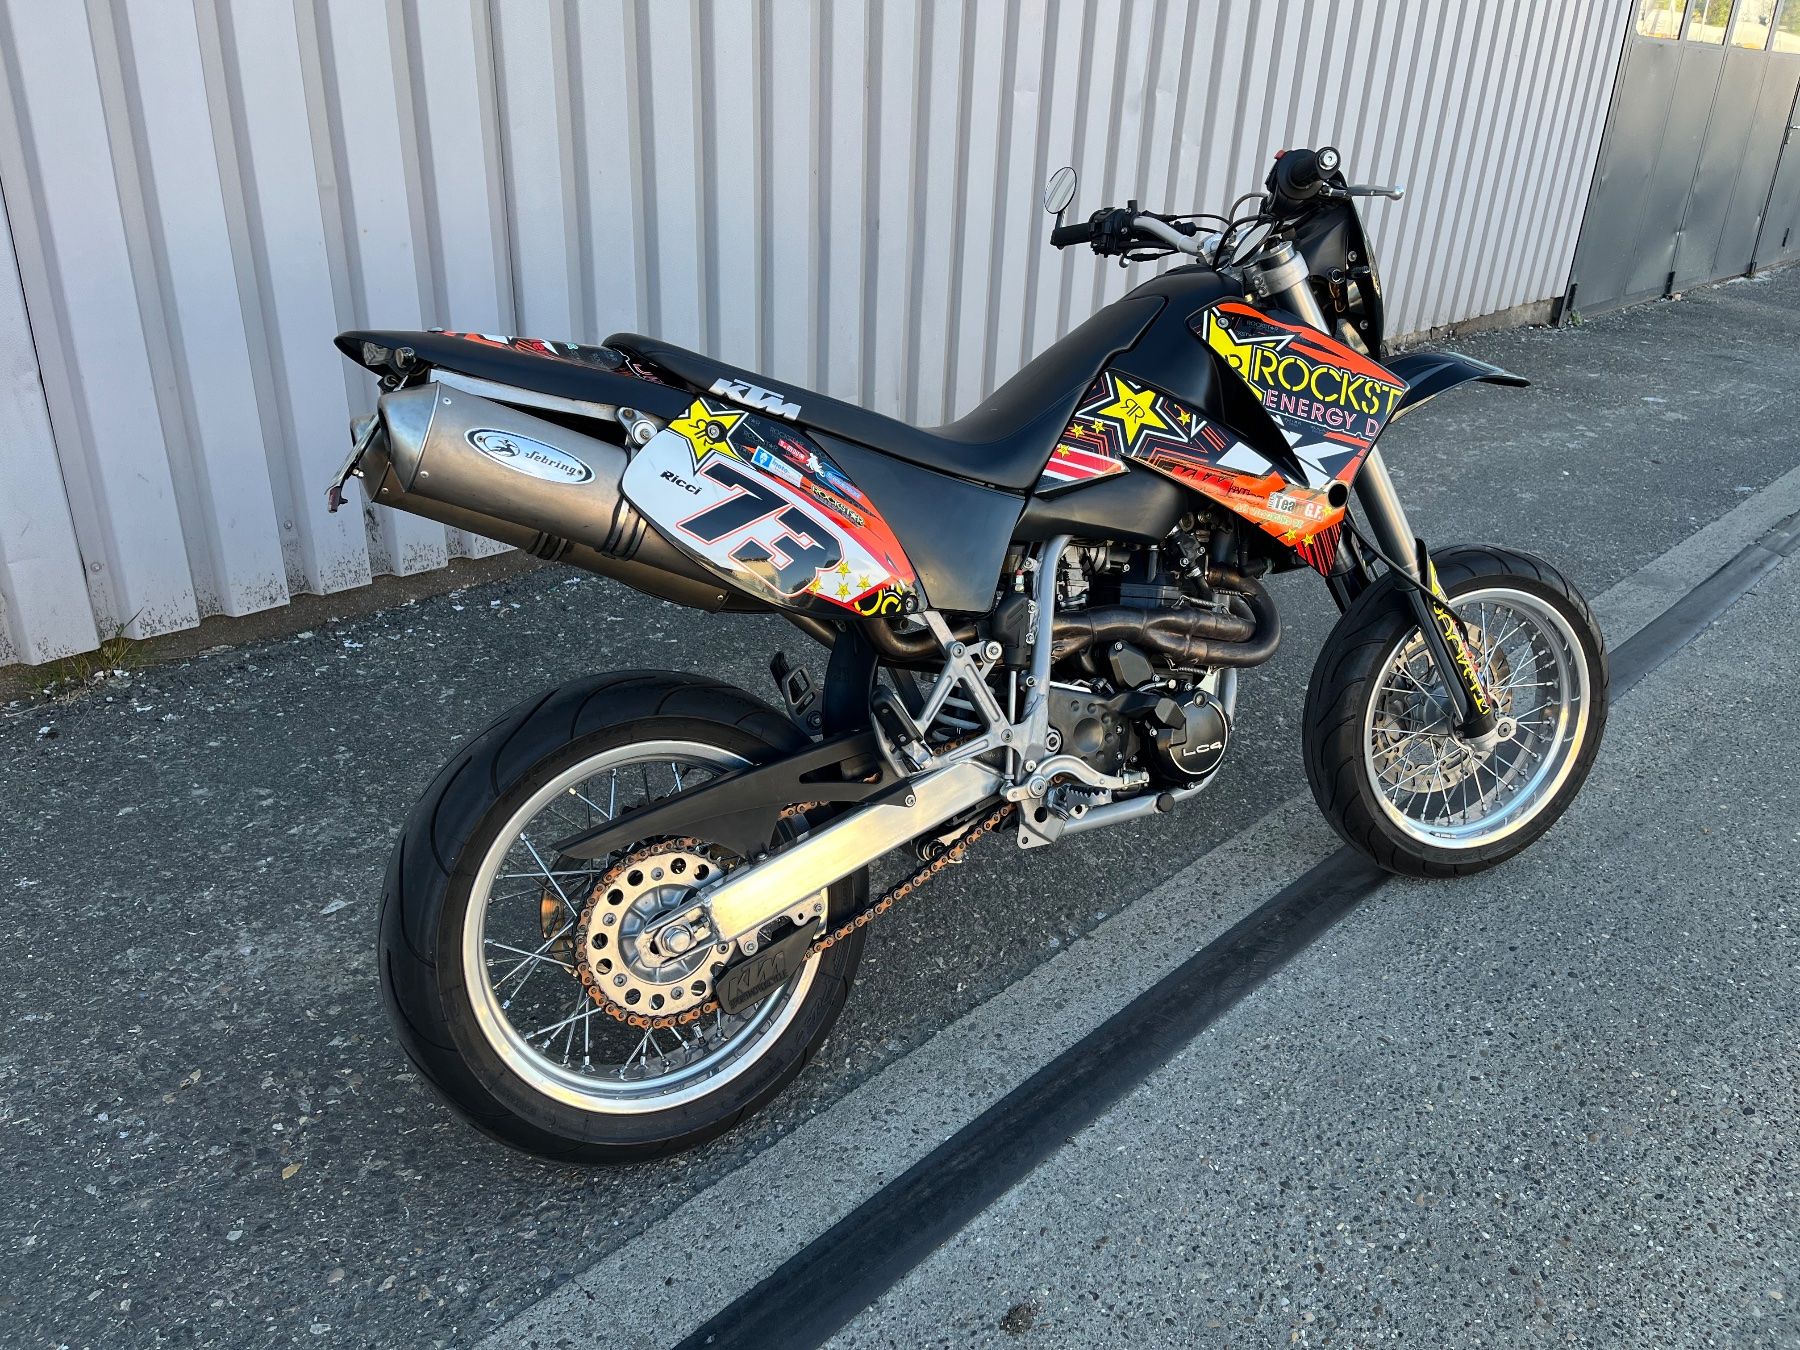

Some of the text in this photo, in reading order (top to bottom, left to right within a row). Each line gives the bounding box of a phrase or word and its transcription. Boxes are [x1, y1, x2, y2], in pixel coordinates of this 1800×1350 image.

[708, 377, 802, 421] KTM
[1265, 388, 1358, 430] ENERGY
[525, 450, 577, 476] Sebring
[660, 470, 703, 495] Ricci
[1273, 494, 1303, 515] Tea
[676, 460, 845, 598] 73
[1182, 741, 1223, 757] LC4
[728, 951, 786, 1001] KTM
